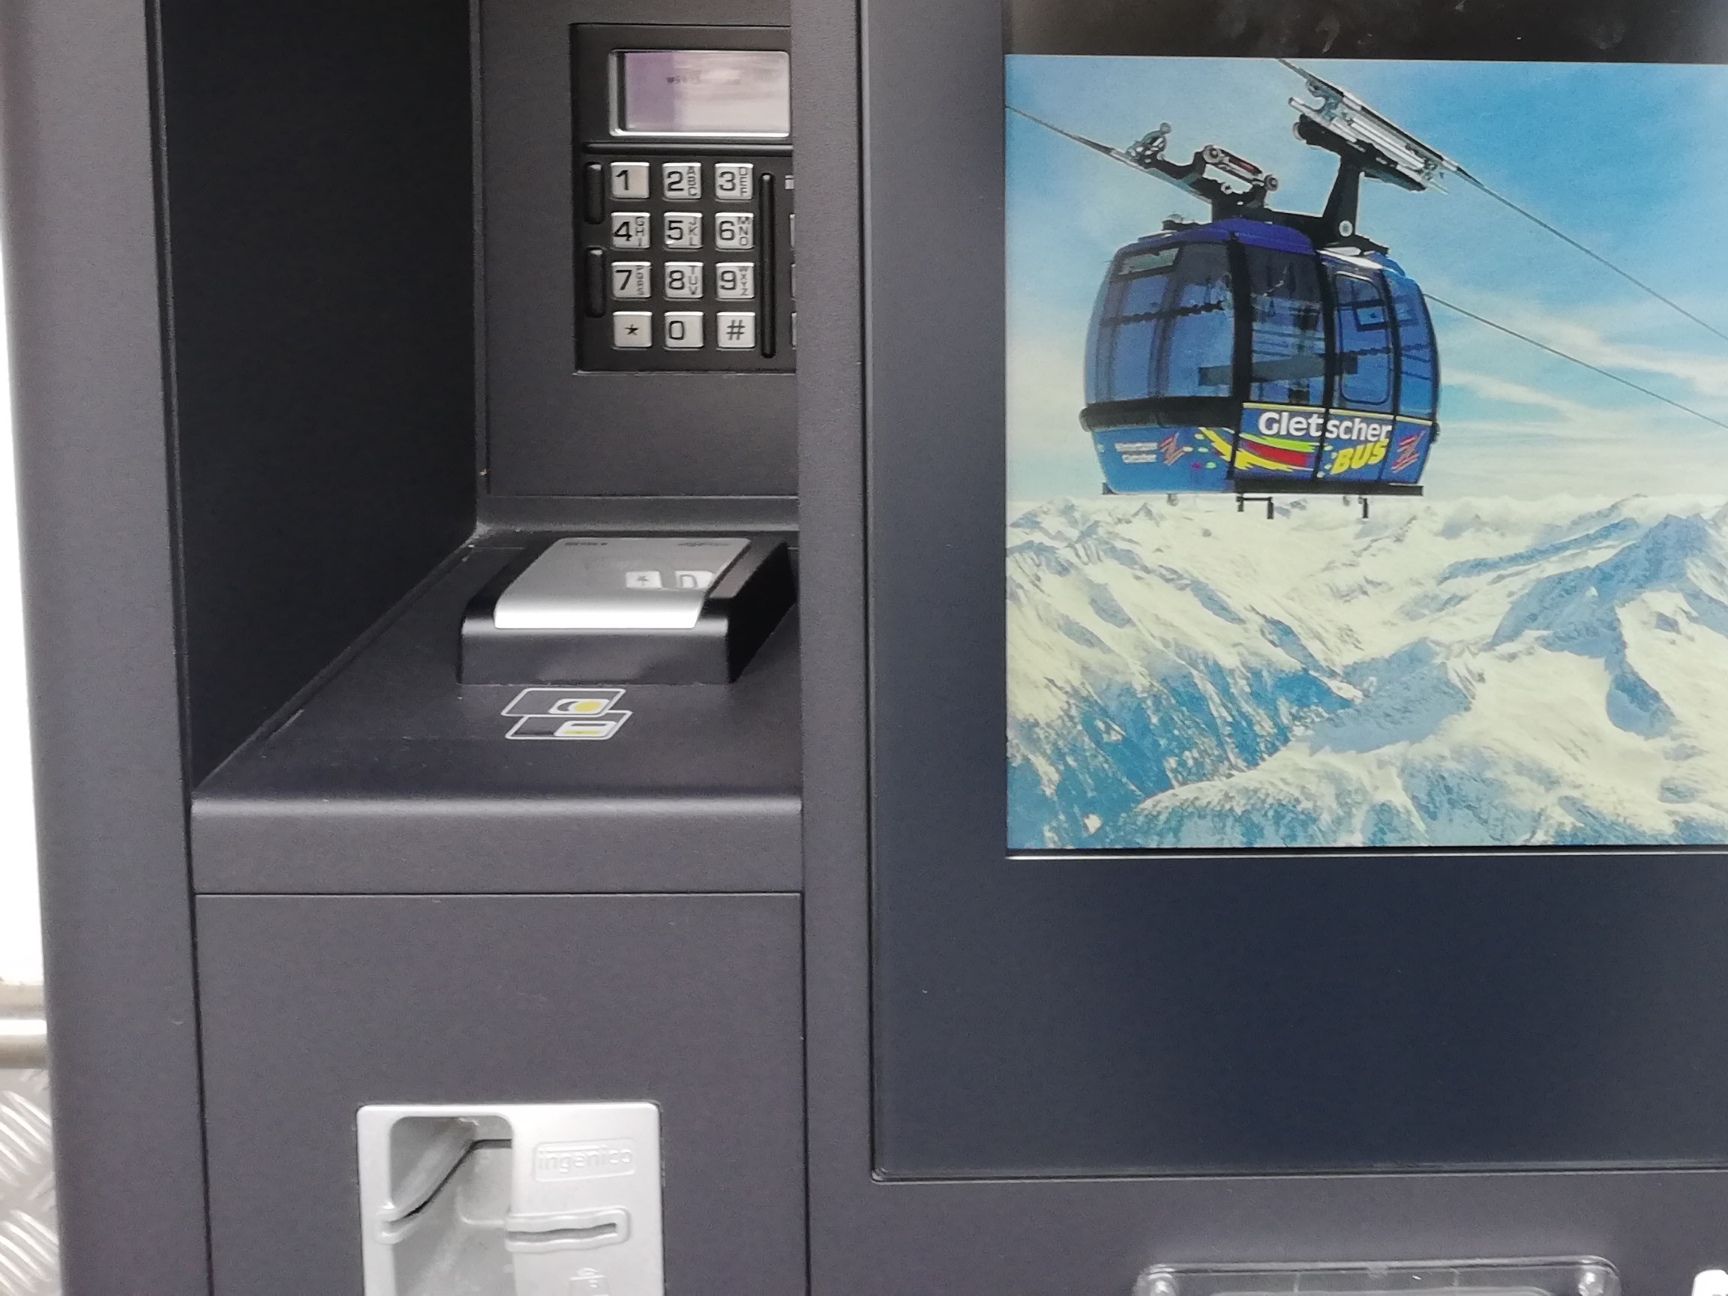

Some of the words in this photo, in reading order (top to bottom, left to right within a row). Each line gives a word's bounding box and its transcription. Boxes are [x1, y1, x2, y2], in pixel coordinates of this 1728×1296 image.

[615, 169, 630, 191] 1
[666, 171, 685, 192] 2
[718, 171, 736, 192] 3
[614, 221, 633, 242] 4
[667, 220, 684, 241] 5
[719, 220, 735, 241] 6
[615, 269, 633, 291] 7
[668, 270, 685, 290] 8
[720, 270, 737, 291] 9
[668, 320, 685, 341] 0
[1257, 410, 1393, 442] Gletscher
[1330, 438, 1390, 475] BUS
